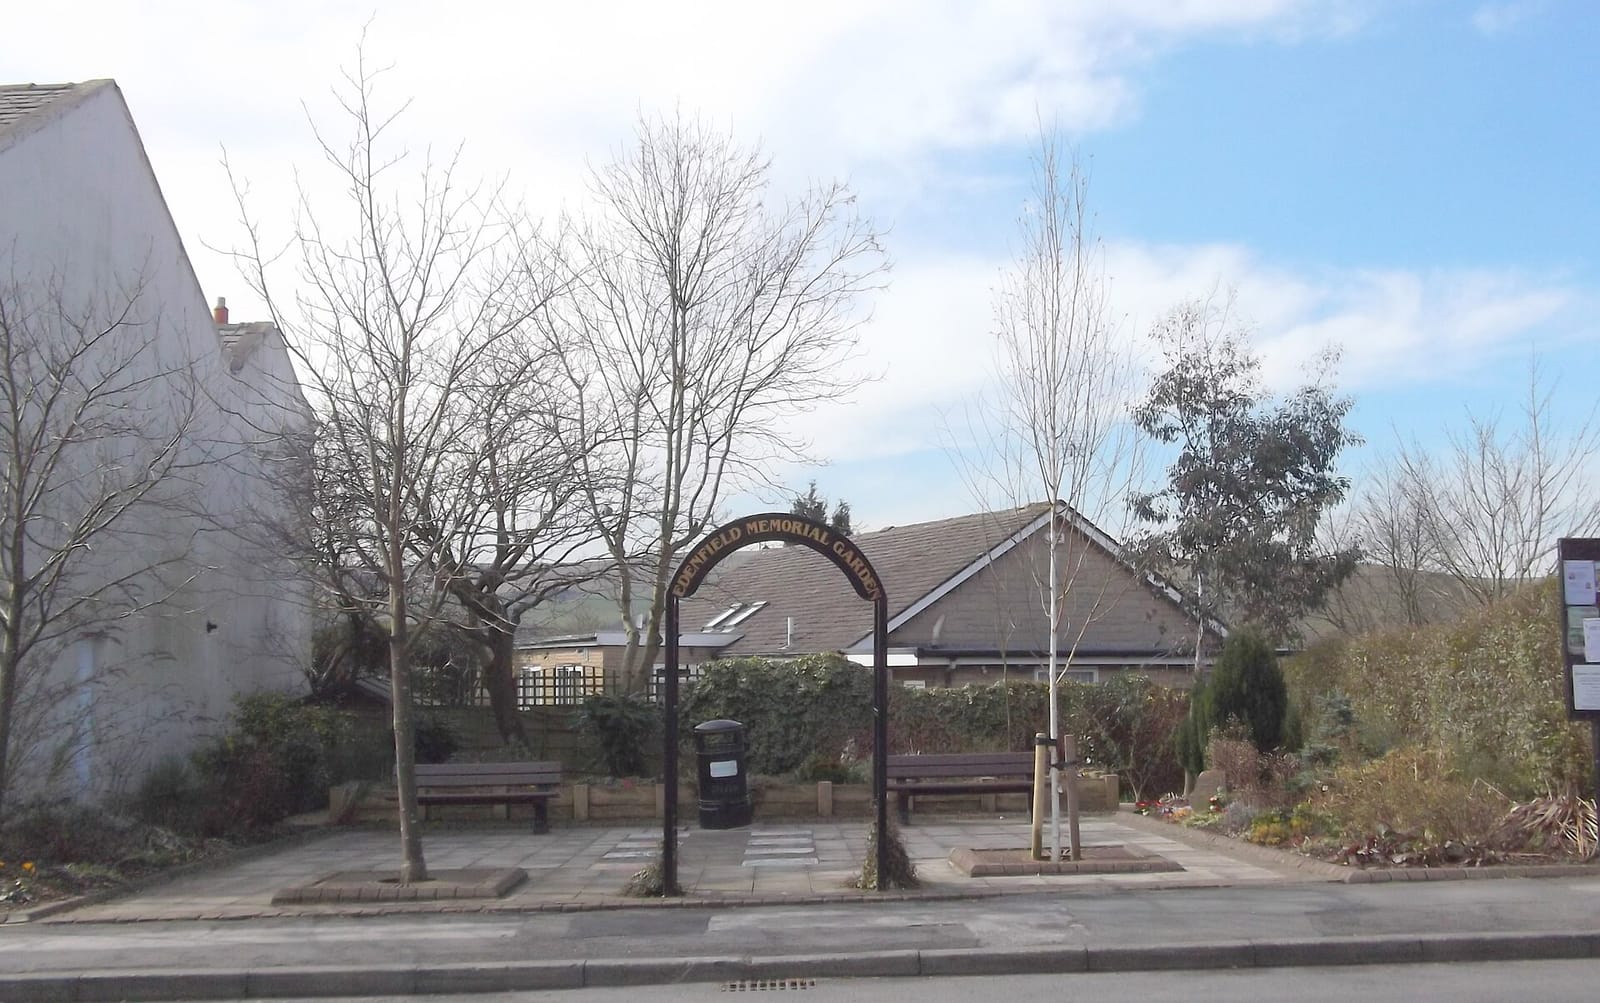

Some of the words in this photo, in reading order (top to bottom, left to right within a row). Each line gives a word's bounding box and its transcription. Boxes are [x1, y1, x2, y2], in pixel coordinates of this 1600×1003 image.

[673, 527, 742, 596] EDENFIELD
[747, 519, 829, 545] MEMORIAL
[833, 541, 881, 600] GARDEN
